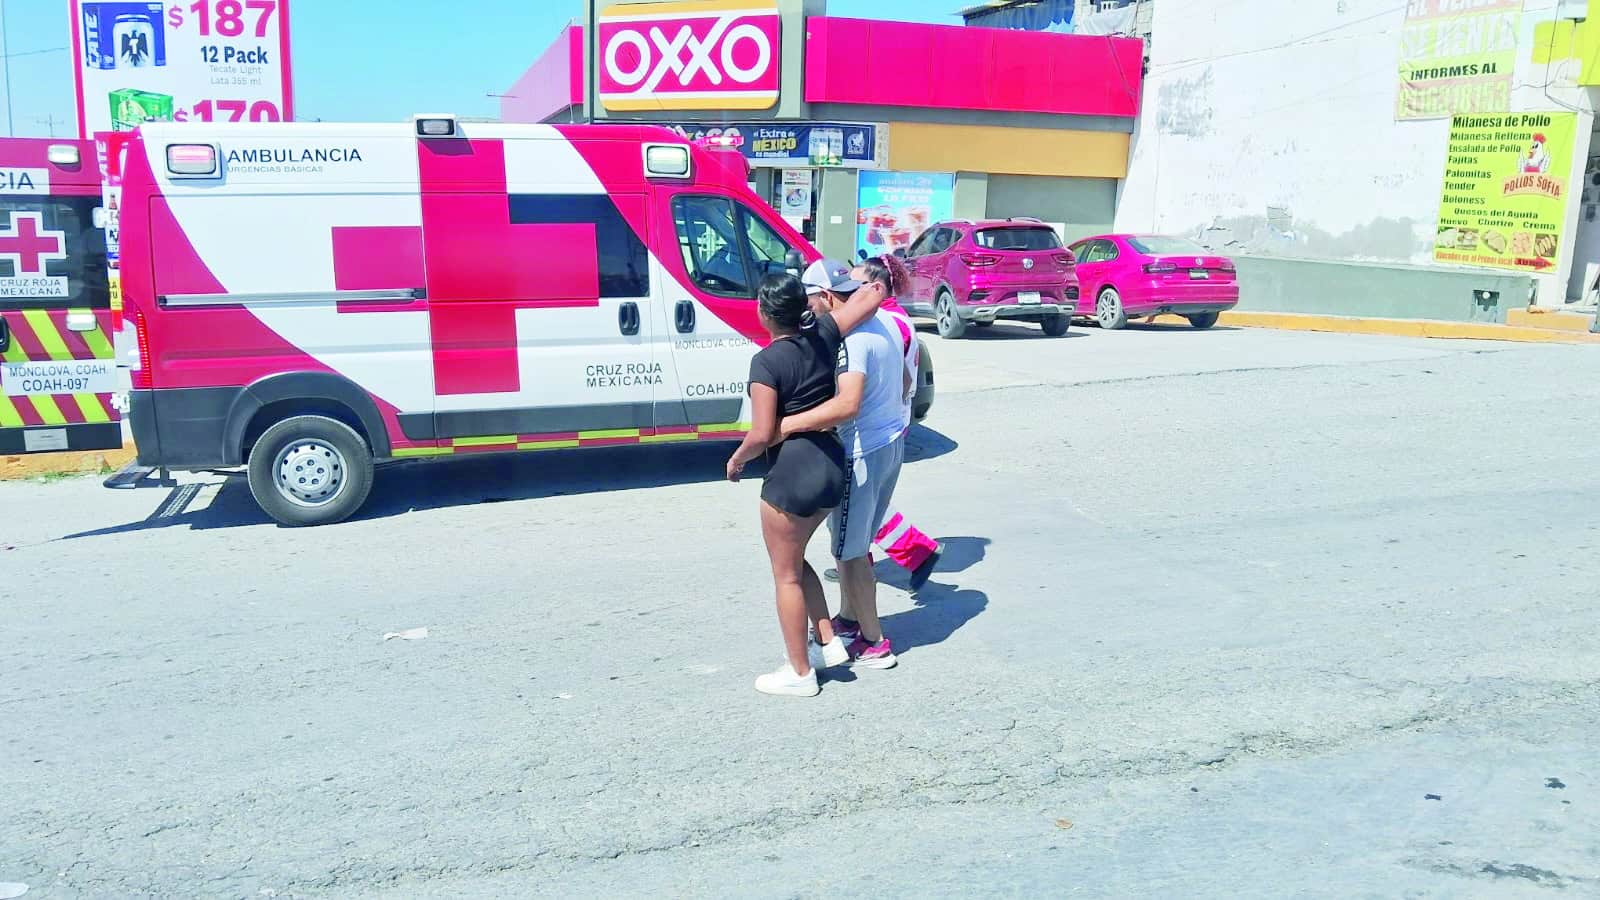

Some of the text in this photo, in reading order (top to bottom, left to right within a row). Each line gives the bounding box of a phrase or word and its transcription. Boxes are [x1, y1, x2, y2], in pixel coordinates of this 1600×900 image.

[200, 45, 269, 64] 12 Pack
[605, 20, 771, 93] OXXO
[209, 65, 264, 76] Tecate Light
[1410, 62, 1497, 80] INFORMES AL
[210, 77, 230, 85] Lata
[1452, 114, 1551, 129] Milanesa de Pollo
[760, 128, 787, 138] Extra
[1450, 131, 1532, 141] Milanesa Rellena
[1449, 143, 1522, 153] Ensalada de Pollo
[227, 148, 363, 162] AMBULANCIA
[1448, 155, 1479, 165] Fajitas
[227, 165, 282, 173] URGENCIAS
[1445, 169, 1493, 179] Palomitas
[1444, 181, 1476, 191] Tender
[1504, 175, 1534, 194] POLLOS
[1454, 207, 1489, 217] Quesos
[1490, 209, 1506, 218] del
[1440, 217, 1557, 231] Huevo Chorizo Crema
[0, 278, 61, 287] CRUZ ROJA
[0, 287, 62, 296] MEXICANA
[10, 364, 106, 378] MONCLOVA, COAH
[586, 362, 663, 377] CRUZ ROJA
[22, 377, 89, 392] COAH-097
[586, 375, 664, 388] MEXICANA
